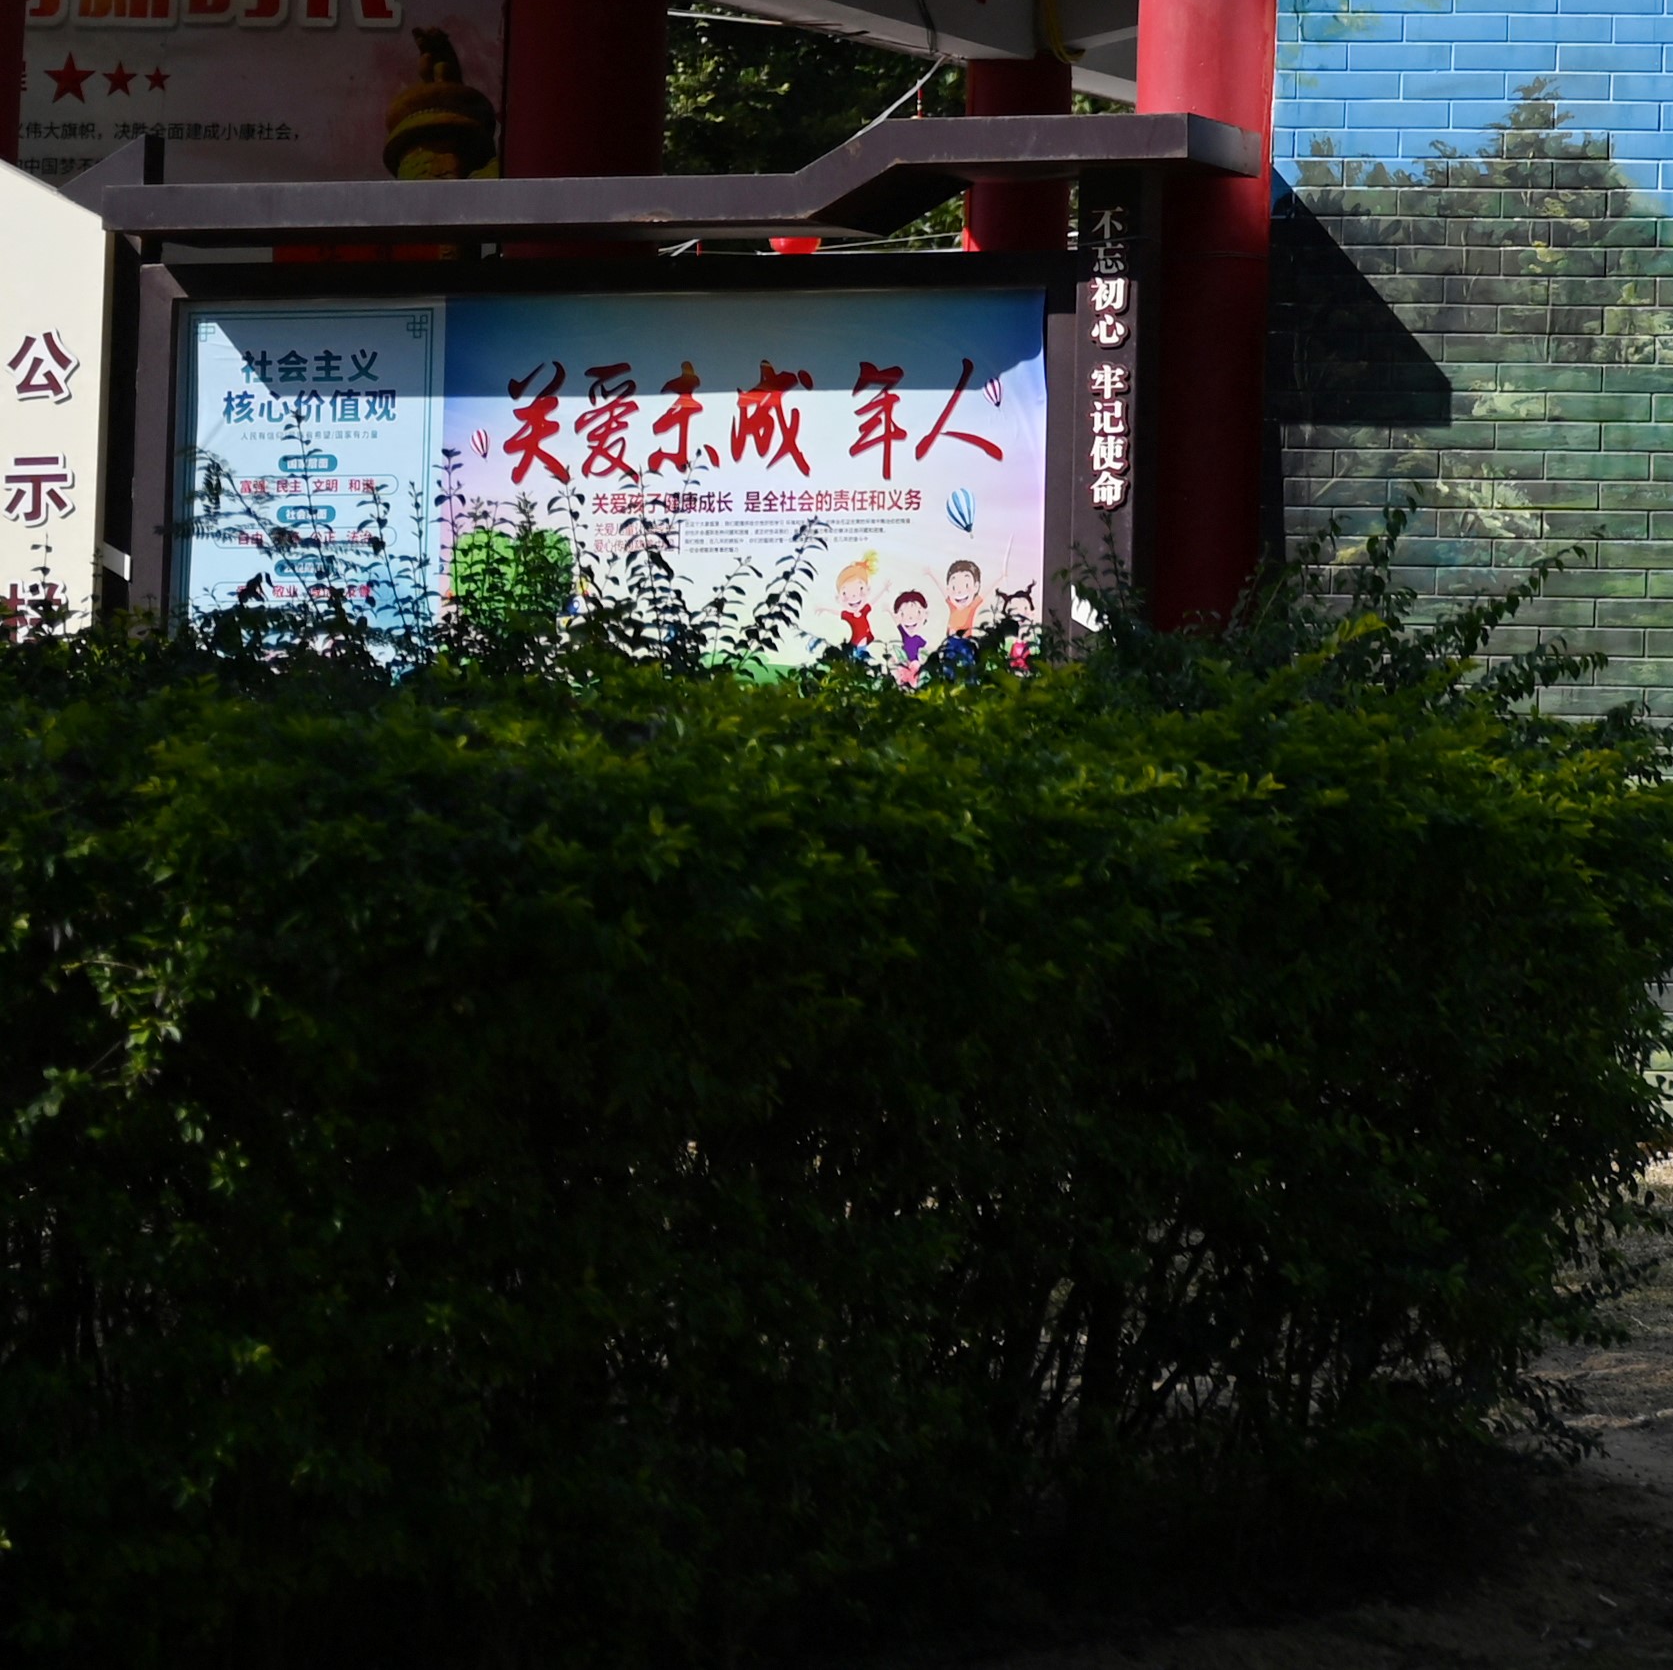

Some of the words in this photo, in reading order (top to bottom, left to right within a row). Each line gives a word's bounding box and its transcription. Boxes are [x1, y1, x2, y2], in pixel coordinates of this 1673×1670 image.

[1090, 206, 1127, 346] 不忘初心
[241, 348, 380, 384] 社会主义
[223, 388, 397, 424] 核心价值观
[502, 357, 1004, 485] 关爱未成年人
[1089, 363, 1127, 508] 牢记使命
[276, 479, 302, 493] 民主
[312, 478, 339, 493] 文明
[744, 489, 923, 513] 是全社会的责任和义务
